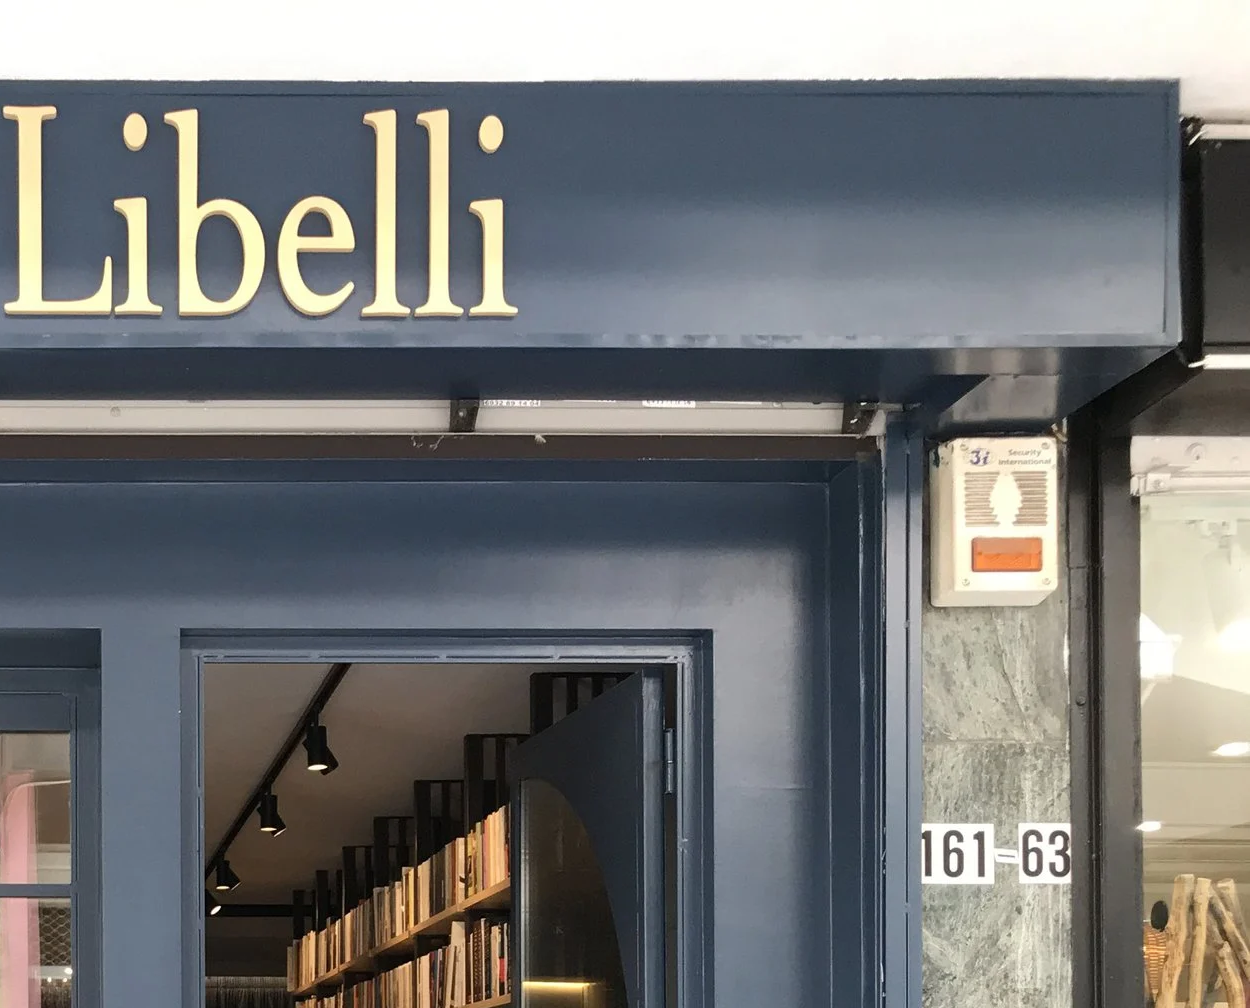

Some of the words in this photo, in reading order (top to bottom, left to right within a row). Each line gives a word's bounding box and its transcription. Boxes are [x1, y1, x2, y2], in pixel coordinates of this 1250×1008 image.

[1, 104, 519, 318] Libelli
[1008, 449, 1042, 457] Security
[998, 458, 1052, 466] International
